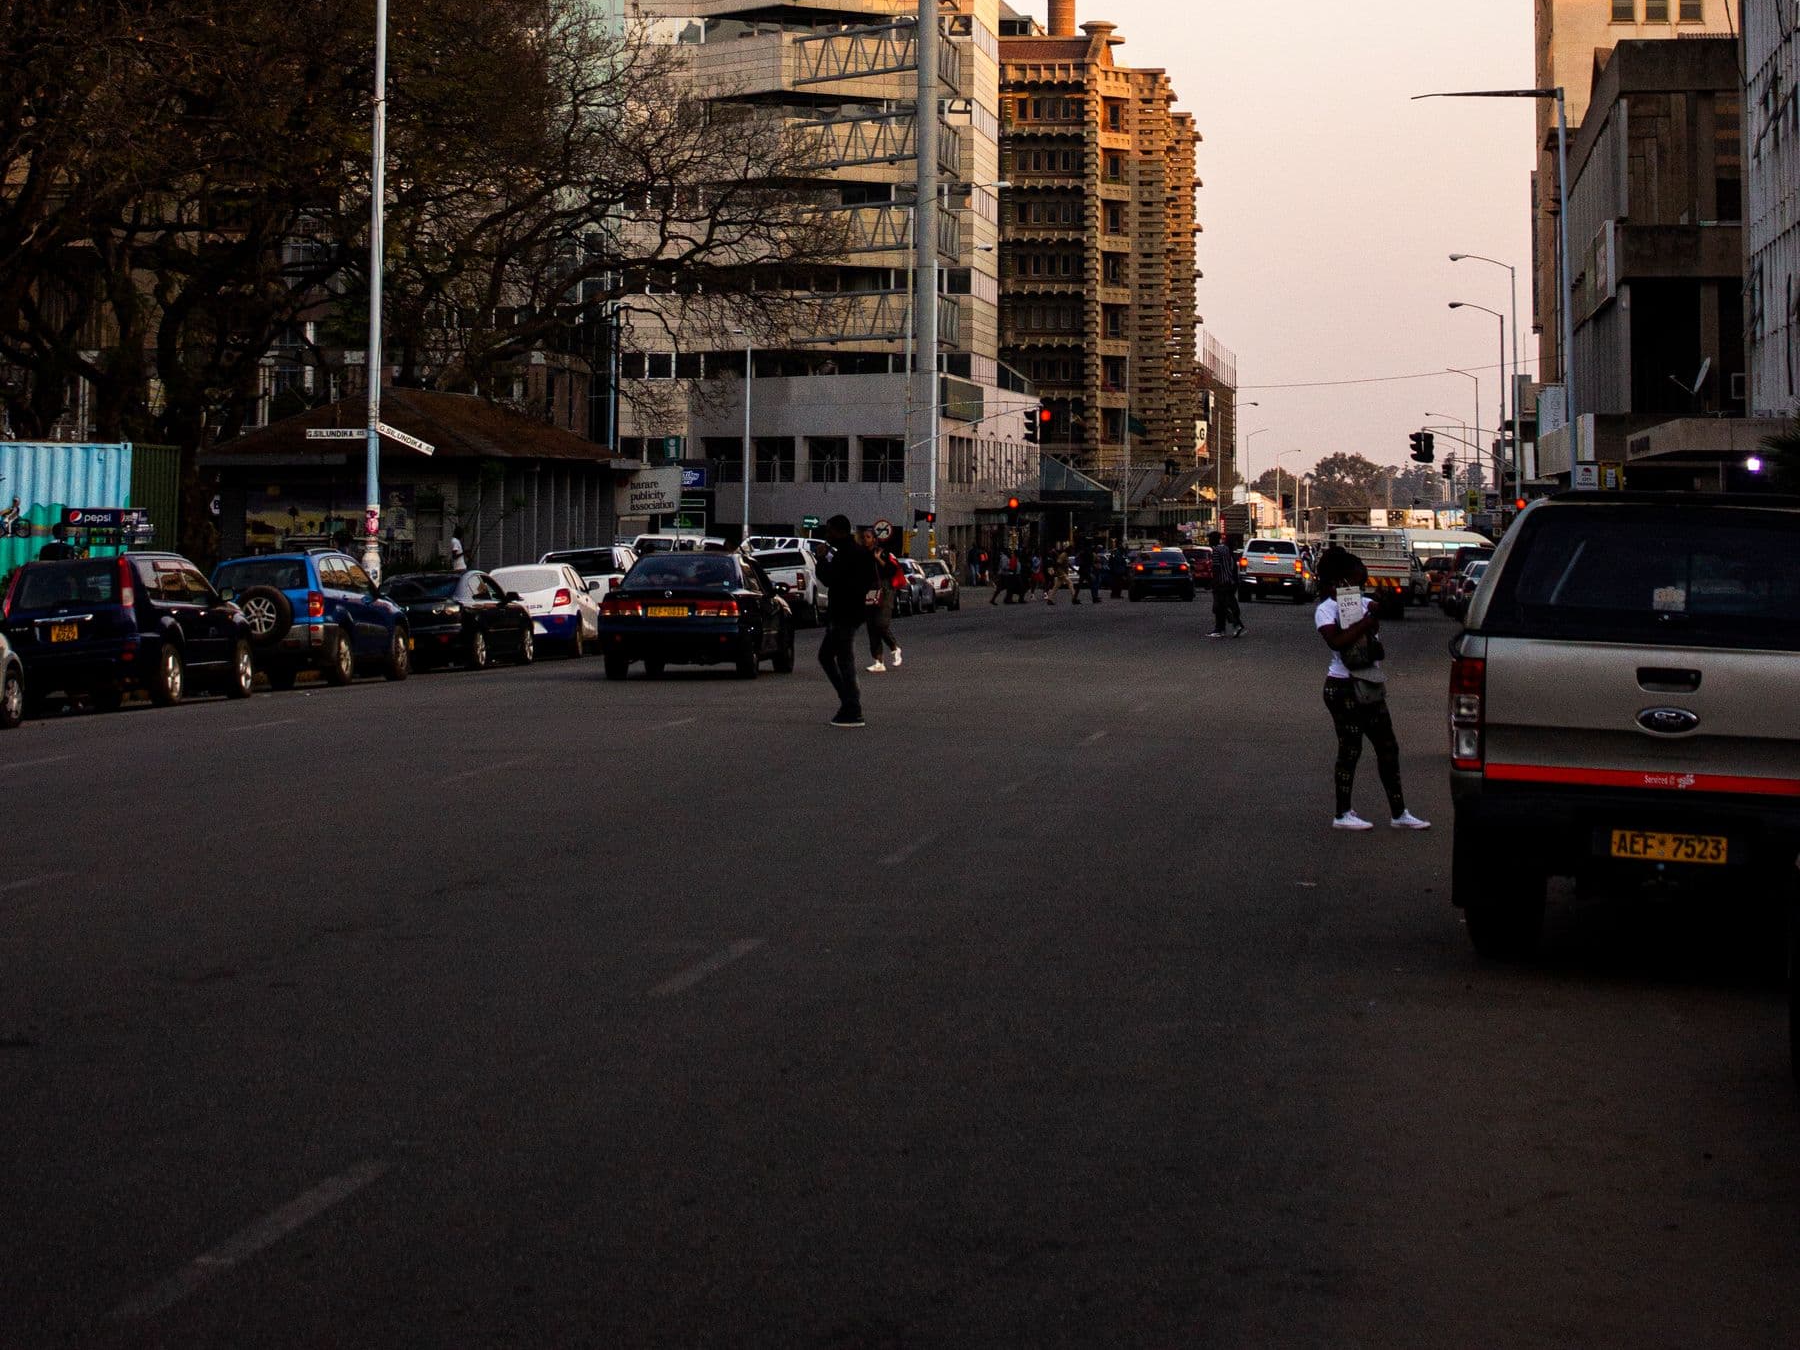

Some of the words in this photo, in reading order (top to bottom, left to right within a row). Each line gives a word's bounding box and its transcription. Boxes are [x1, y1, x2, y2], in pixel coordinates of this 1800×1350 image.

[630, 481, 659, 490] harare
[630, 490, 666, 504] publicity
[630, 499, 675, 511] association
[84, 513, 112, 523] pepsi
[1616, 832, 1656, 856] AEF
[1672, 836, 1722, 860] 7523
